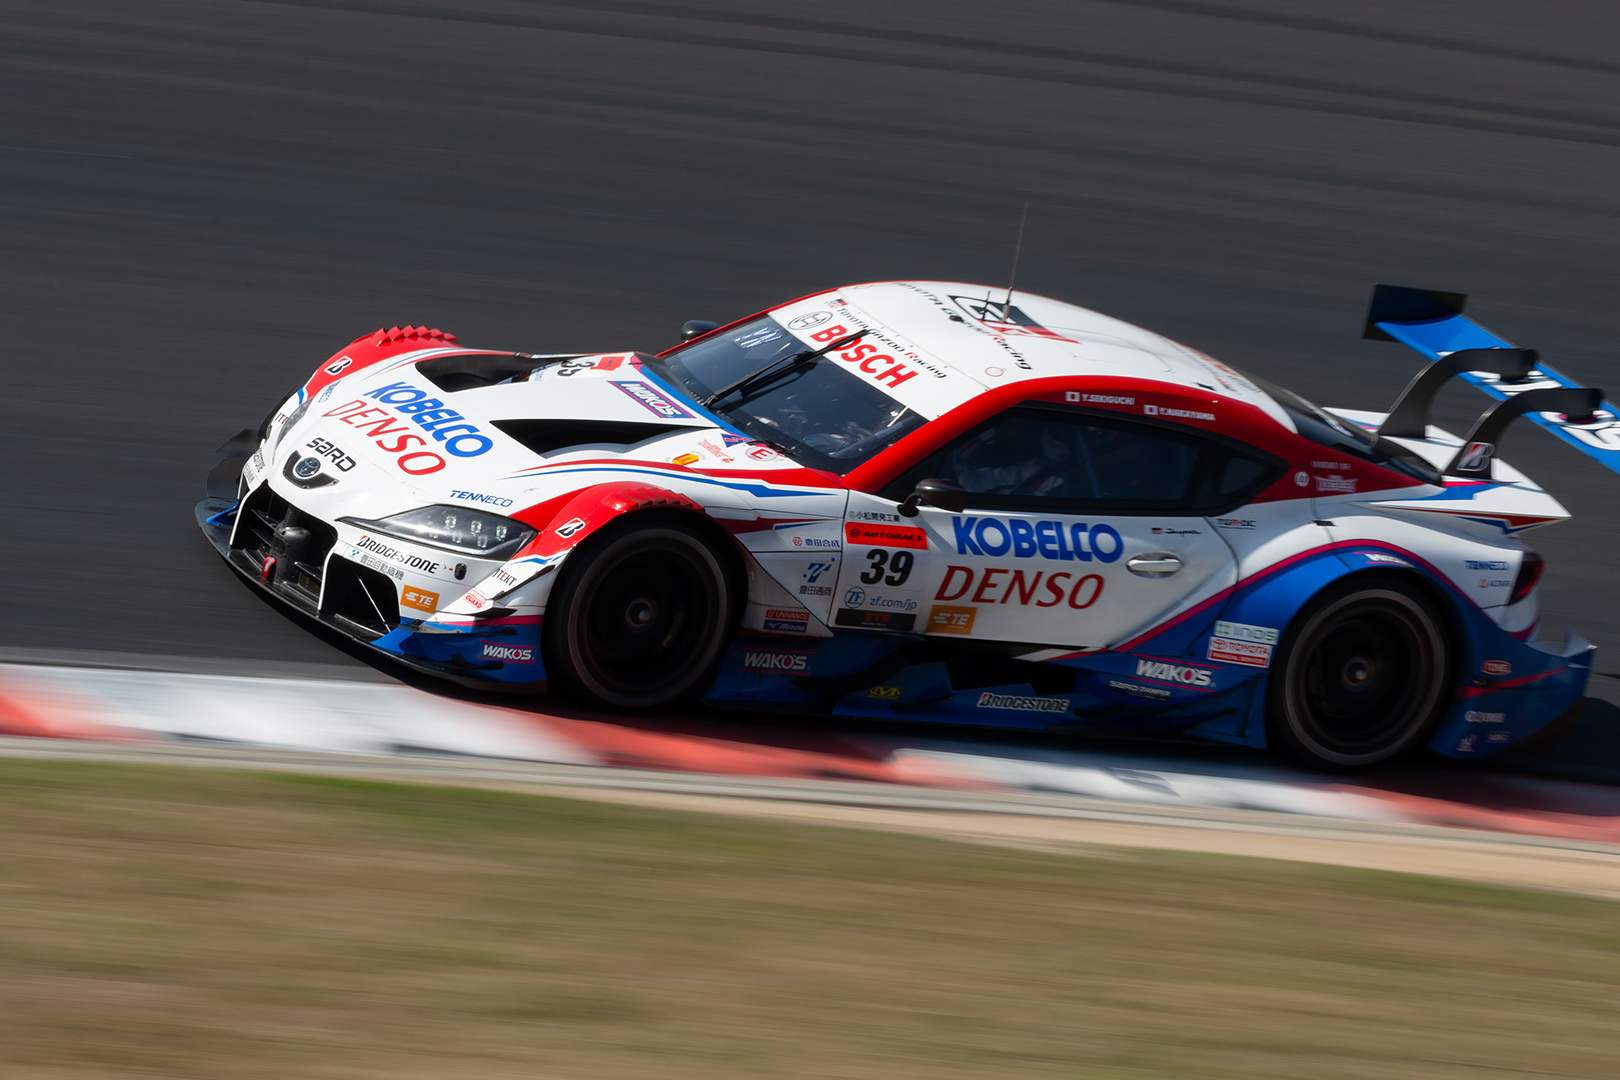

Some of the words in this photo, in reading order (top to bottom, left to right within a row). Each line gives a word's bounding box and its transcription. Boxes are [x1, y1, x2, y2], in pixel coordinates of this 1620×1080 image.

[810, 324, 919, 388] BOSCH
[904, 351, 947, 379] Racing
[362, 381, 494, 457] KOBELCO
[322, 400, 446, 475] DENSO
[450, 489, 513, 508] TENNECO
[863, 531, 923, 541] AUTOBACS
[952, 516, 1124, 563] KOBELCO
[355, 535, 439, 574] BRIDGESTONE
[860, 549, 914, 586] 39
[415, 593, 434, 606] TE
[934, 565, 1105, 610] DENSO
[869, 596, 917, 610] zf.com/jp
[950, 613, 968, 625] TE
[1228, 642, 1269, 656] TOYOTA
[979, 693, 1069, 712] BRIDGESTONE
